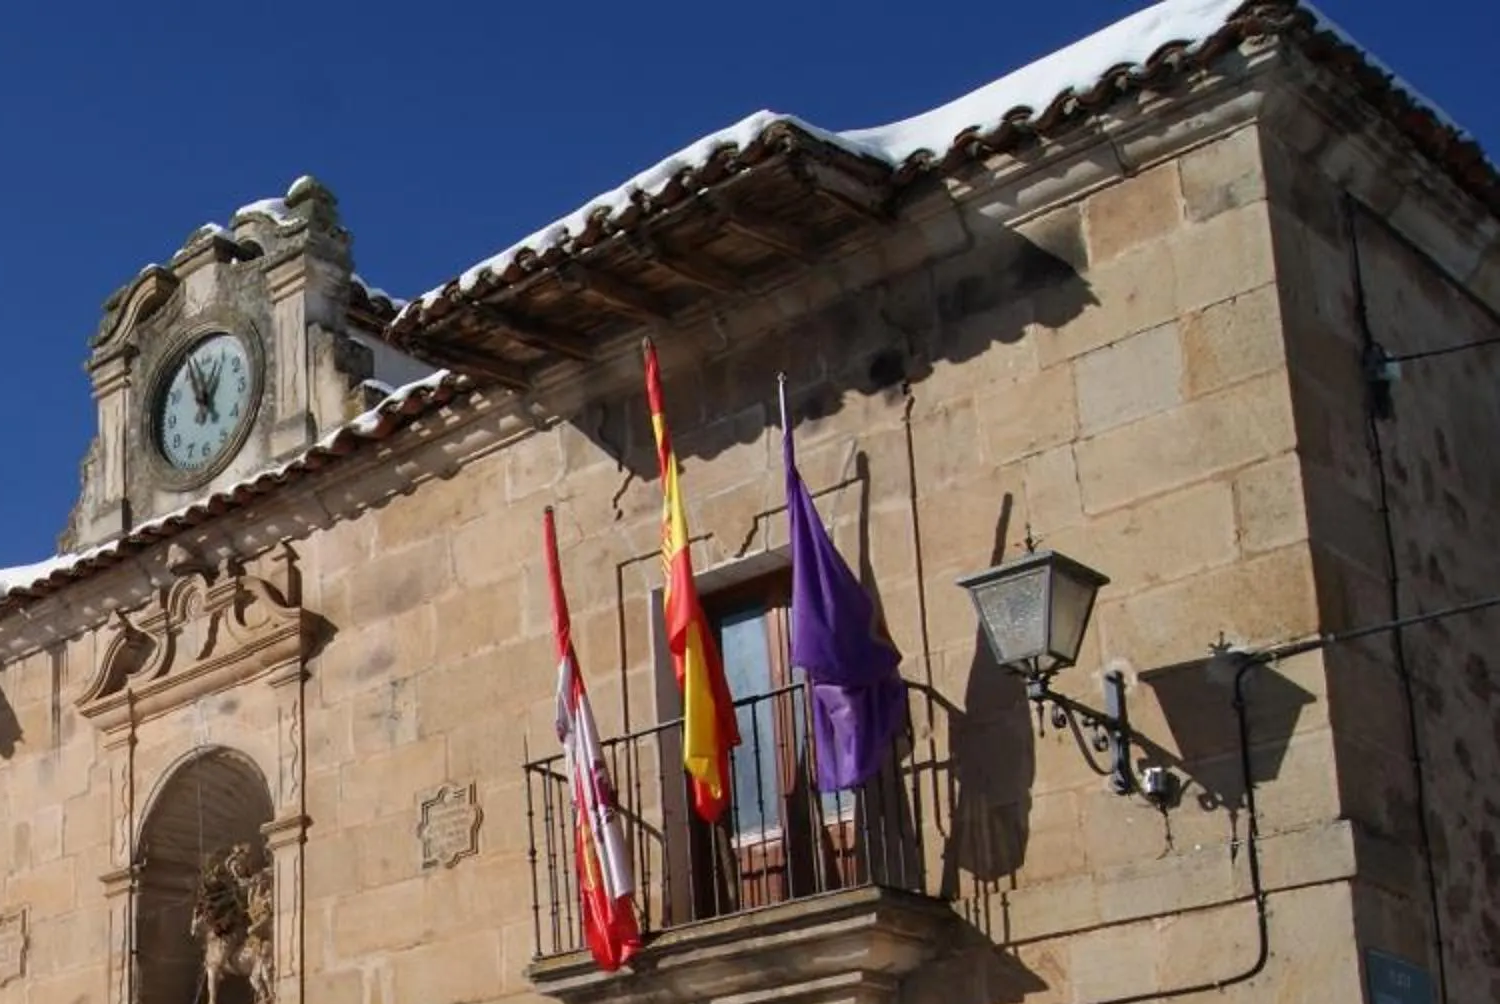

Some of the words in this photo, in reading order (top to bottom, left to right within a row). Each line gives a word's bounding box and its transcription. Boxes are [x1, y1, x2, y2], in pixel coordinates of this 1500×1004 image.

[229, 402, 239, 417] 4
[187, 443, 195, 459] 7
[201, 442, 211, 456] 6
